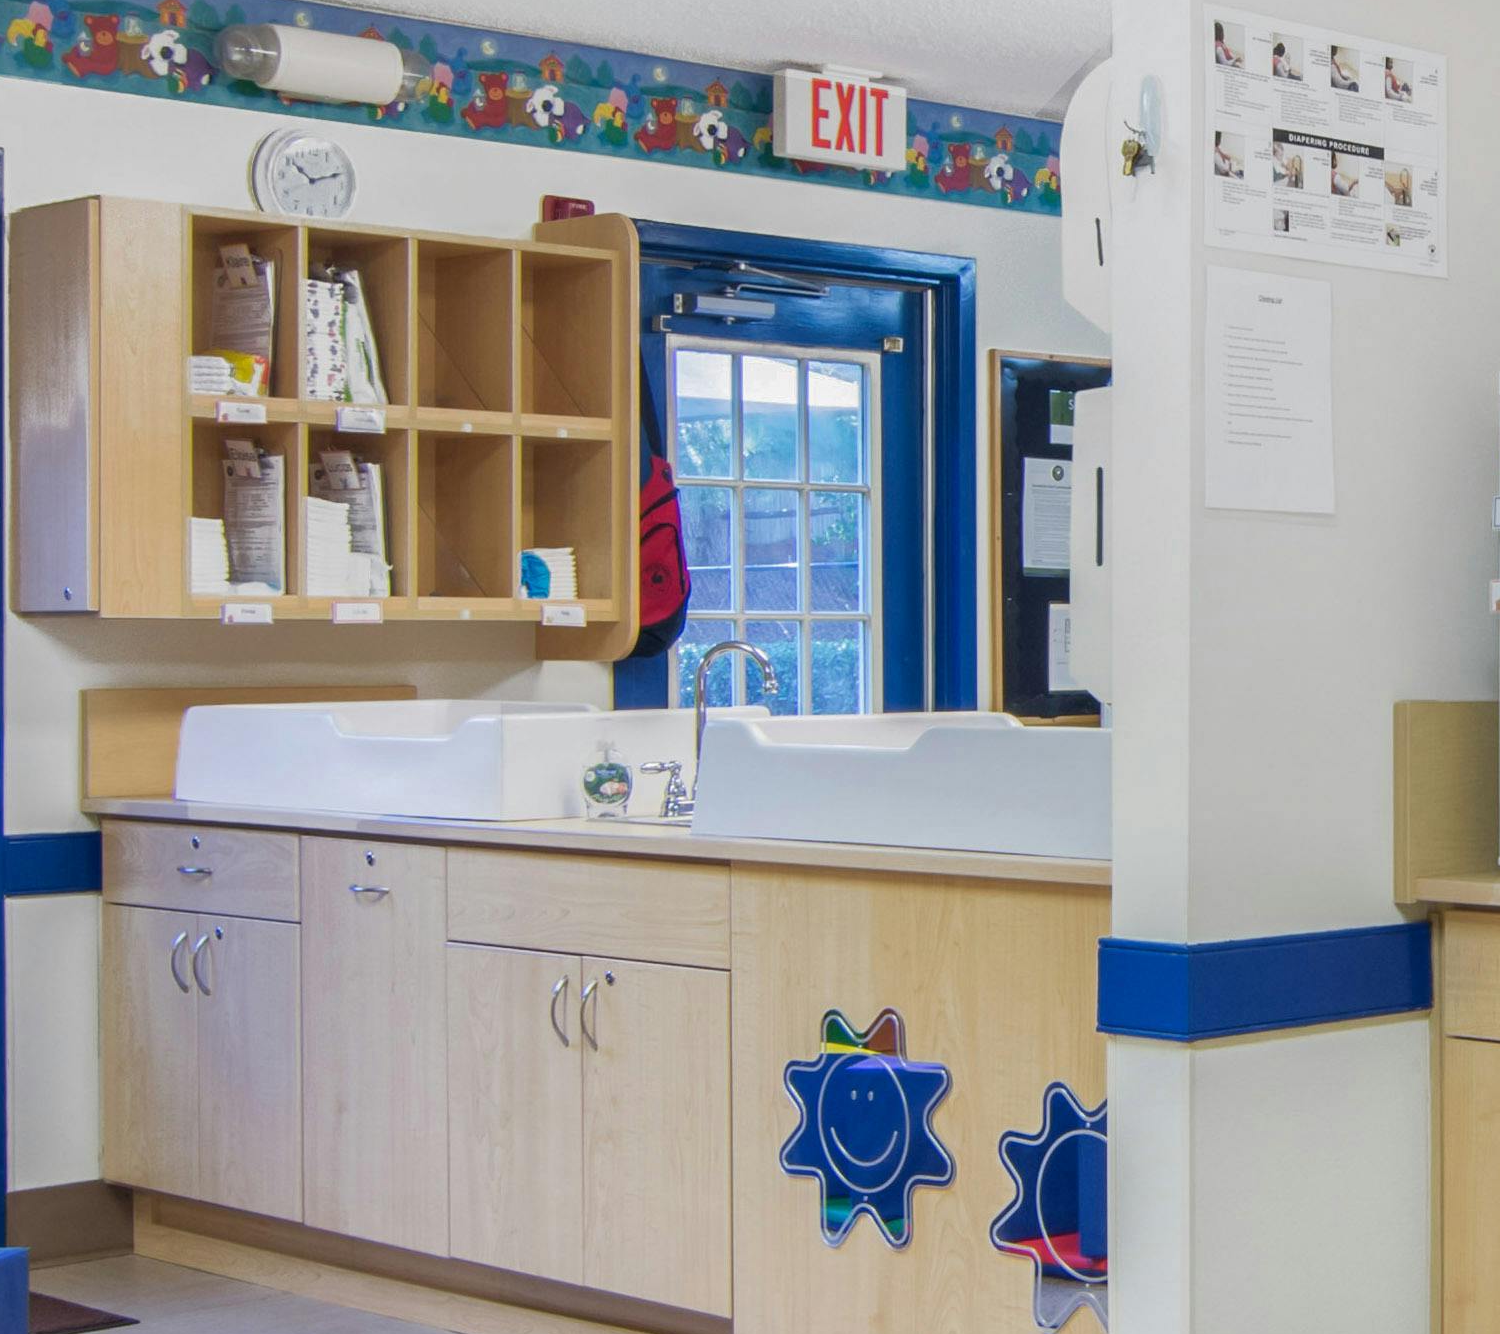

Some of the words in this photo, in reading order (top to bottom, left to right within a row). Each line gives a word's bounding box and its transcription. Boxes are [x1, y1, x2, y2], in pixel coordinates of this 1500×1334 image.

[811, 77, 889, 157] EXIT
[1288, 133, 1328, 148] DIAPERING
[1329, 140, 1370, 156] PROCEDURE
